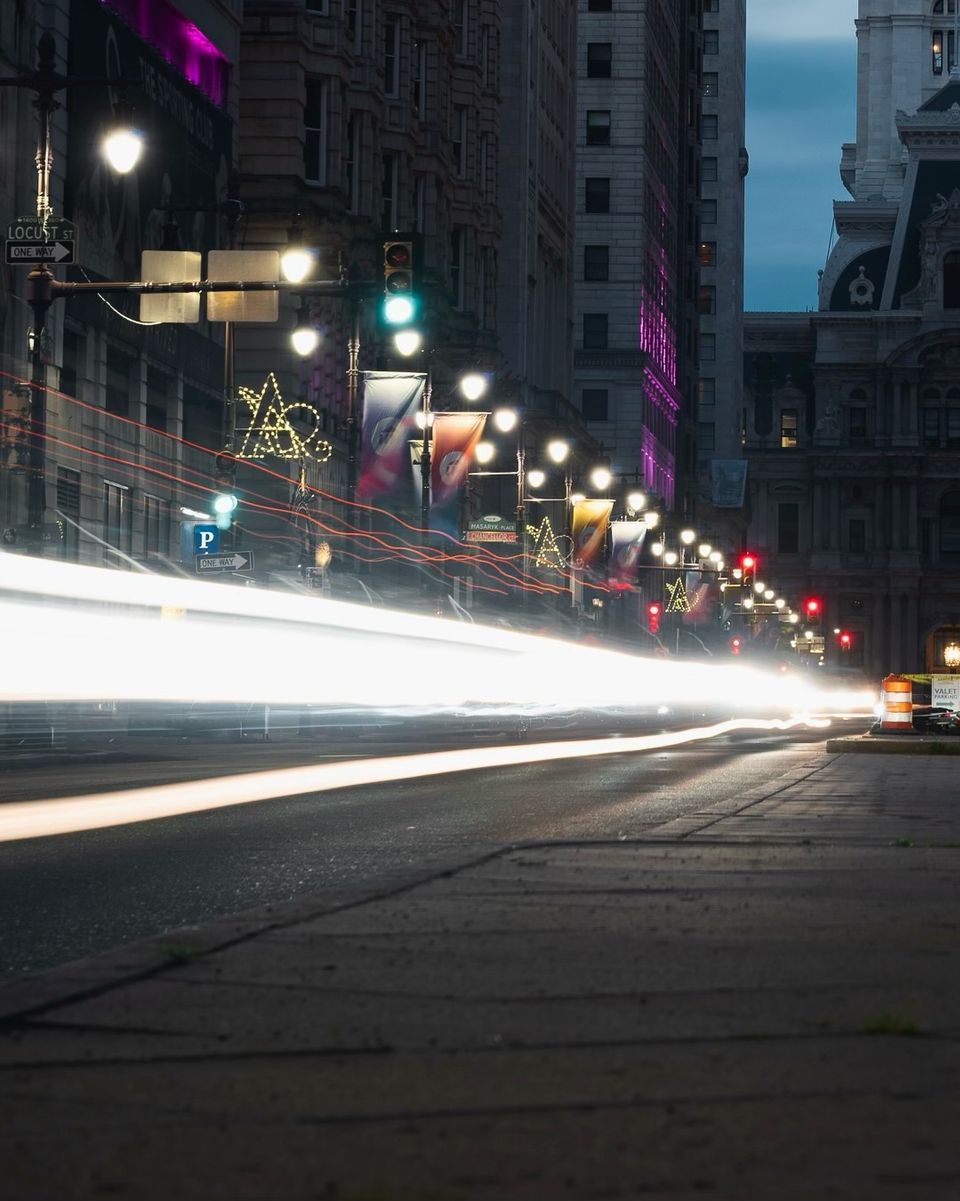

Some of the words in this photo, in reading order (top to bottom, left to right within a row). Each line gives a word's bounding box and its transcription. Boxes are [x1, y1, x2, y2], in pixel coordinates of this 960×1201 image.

[8, 226, 59, 240] LOCUST
[63, 230, 73, 240] ST
[13, 247, 32, 257] ONE
[35, 247, 54, 257] WAY
[199, 531, 215, 549] P
[202, 559, 217, 567] ONE
[219, 558, 234, 566] WAY
